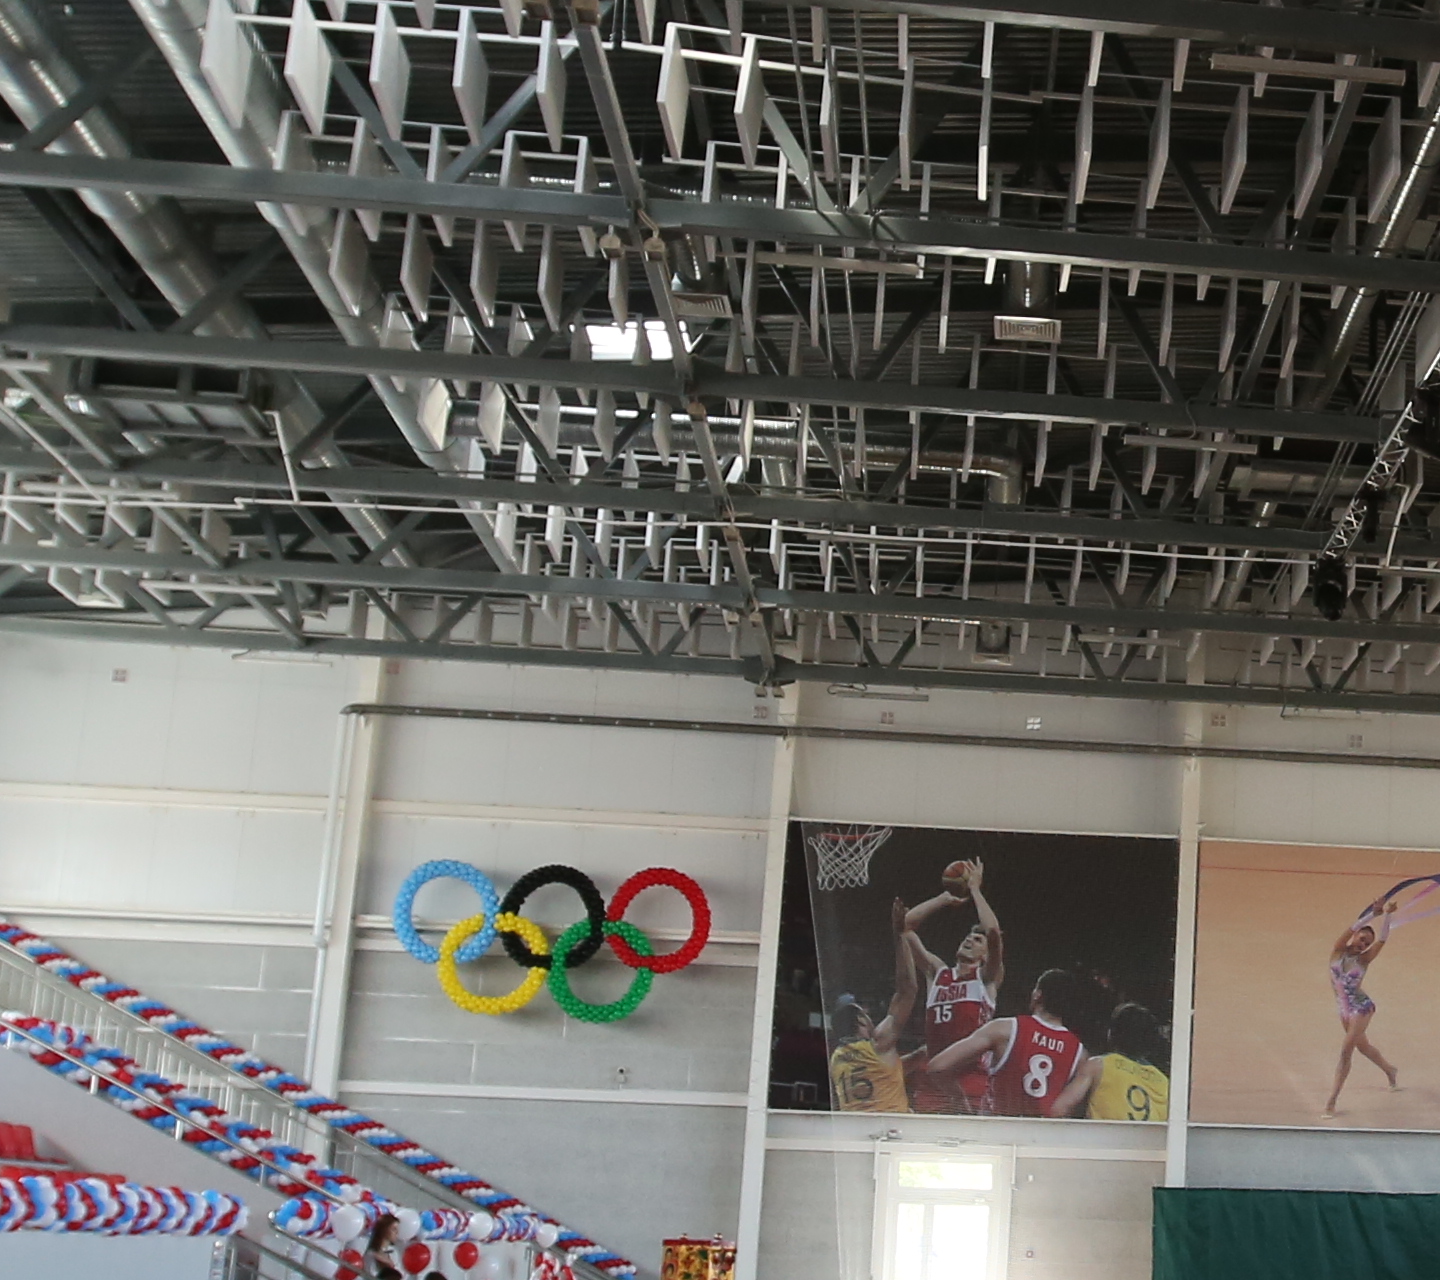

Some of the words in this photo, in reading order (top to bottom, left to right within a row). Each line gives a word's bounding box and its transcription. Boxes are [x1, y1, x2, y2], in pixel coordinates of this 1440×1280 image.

[933, 1005, 952, 1024] 15
[839, 1066, 873, 1103] 15
[1023, 1054, 1053, 1098] 8
[1127, 1085, 1150, 1121] 9
